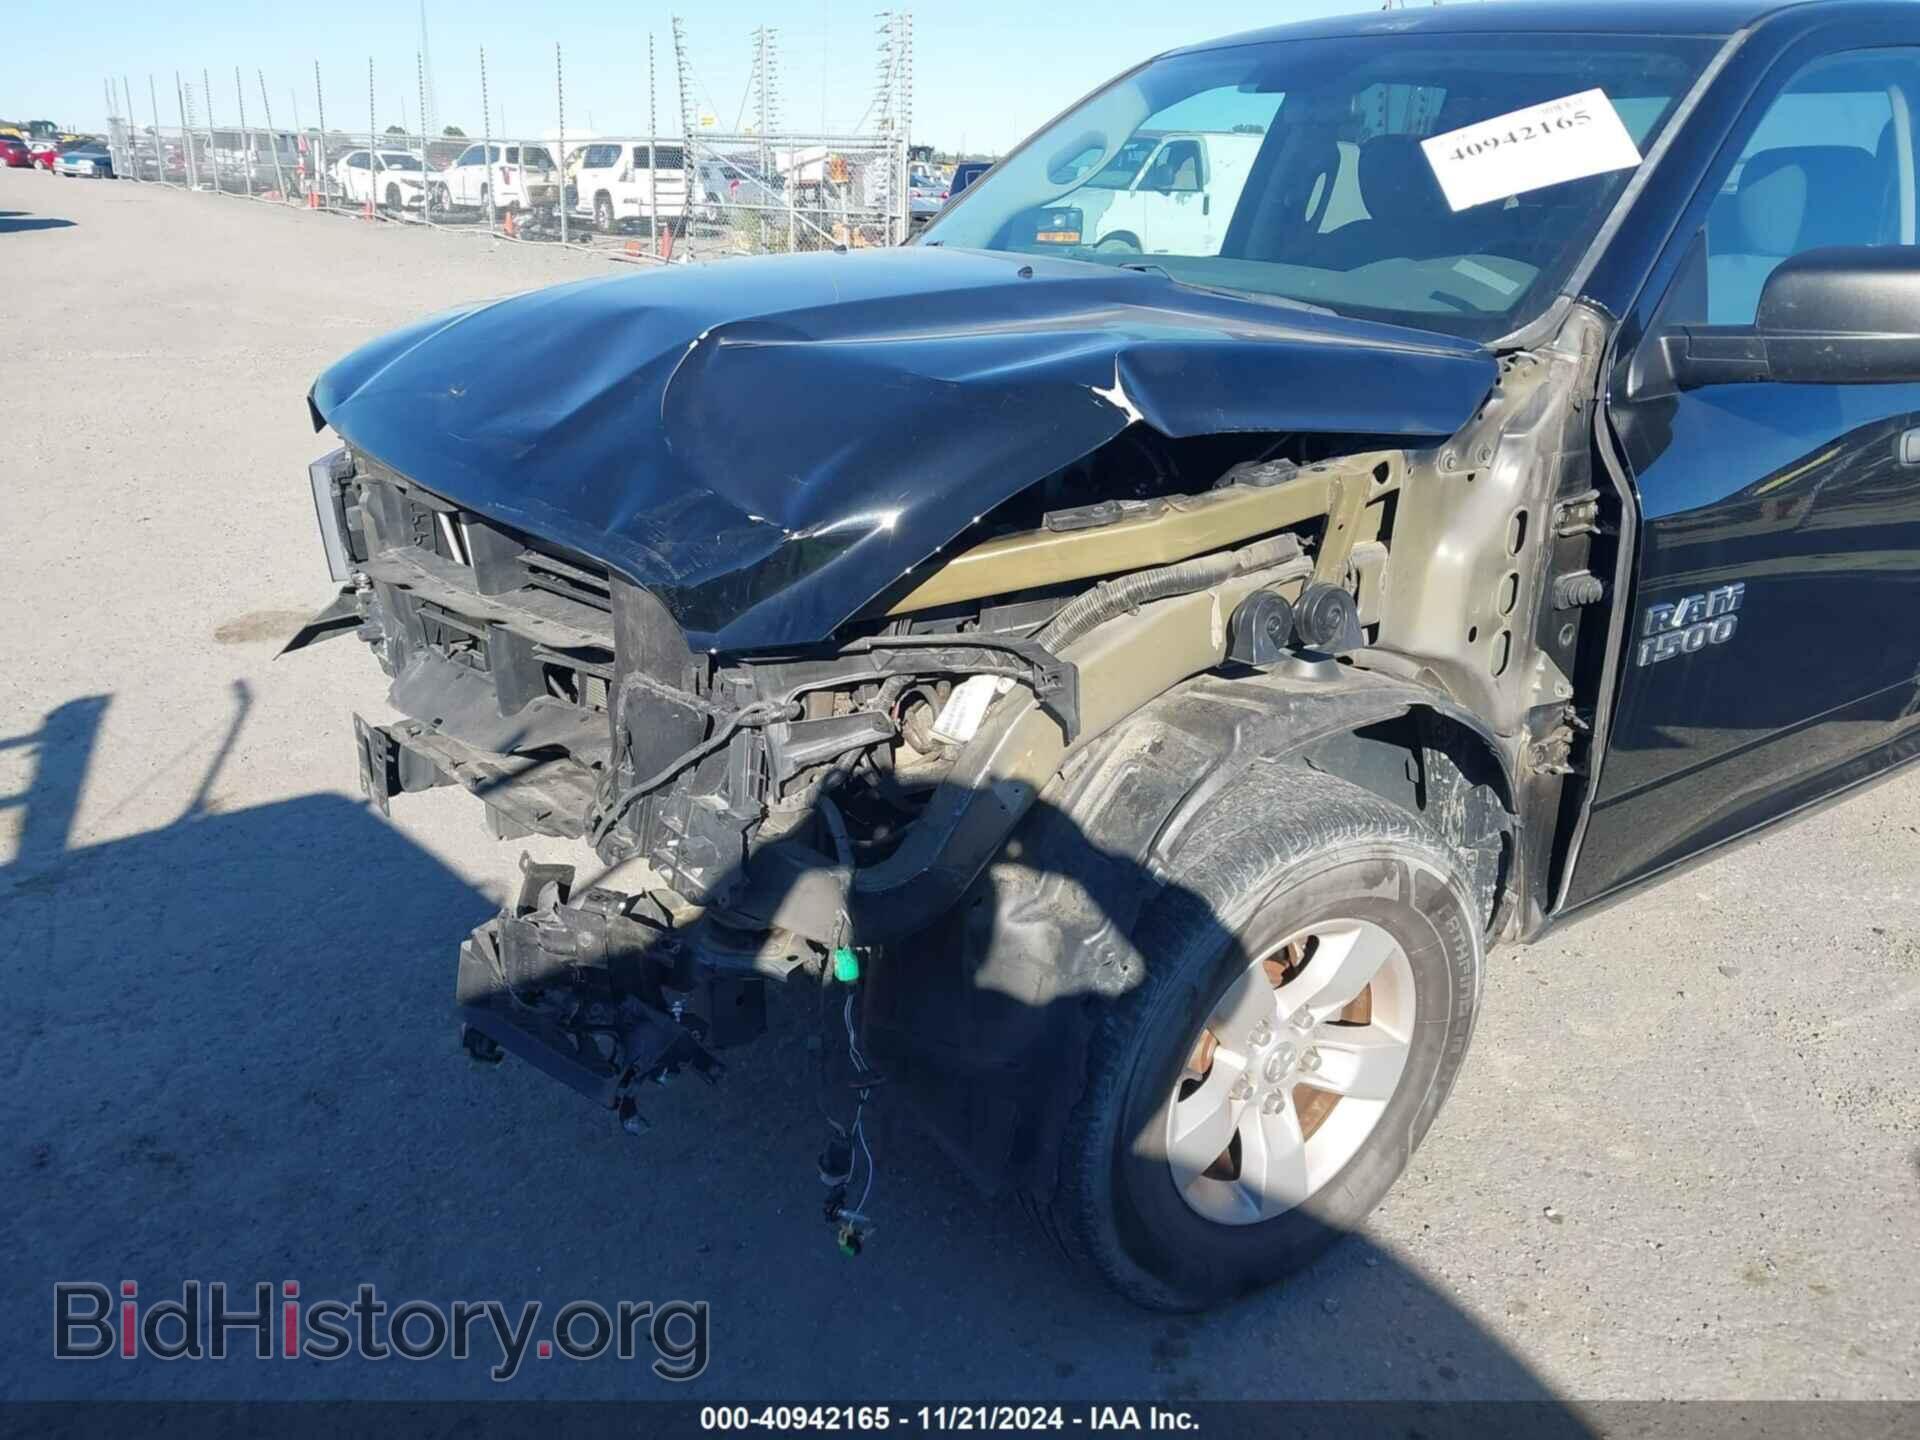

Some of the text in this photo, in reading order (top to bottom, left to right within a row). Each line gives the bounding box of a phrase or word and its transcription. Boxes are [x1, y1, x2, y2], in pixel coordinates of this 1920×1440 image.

[1449, 109, 1592, 162] 40942165
[1642, 581, 1746, 637] RAM
[1636, 613, 1739, 668] 1500
